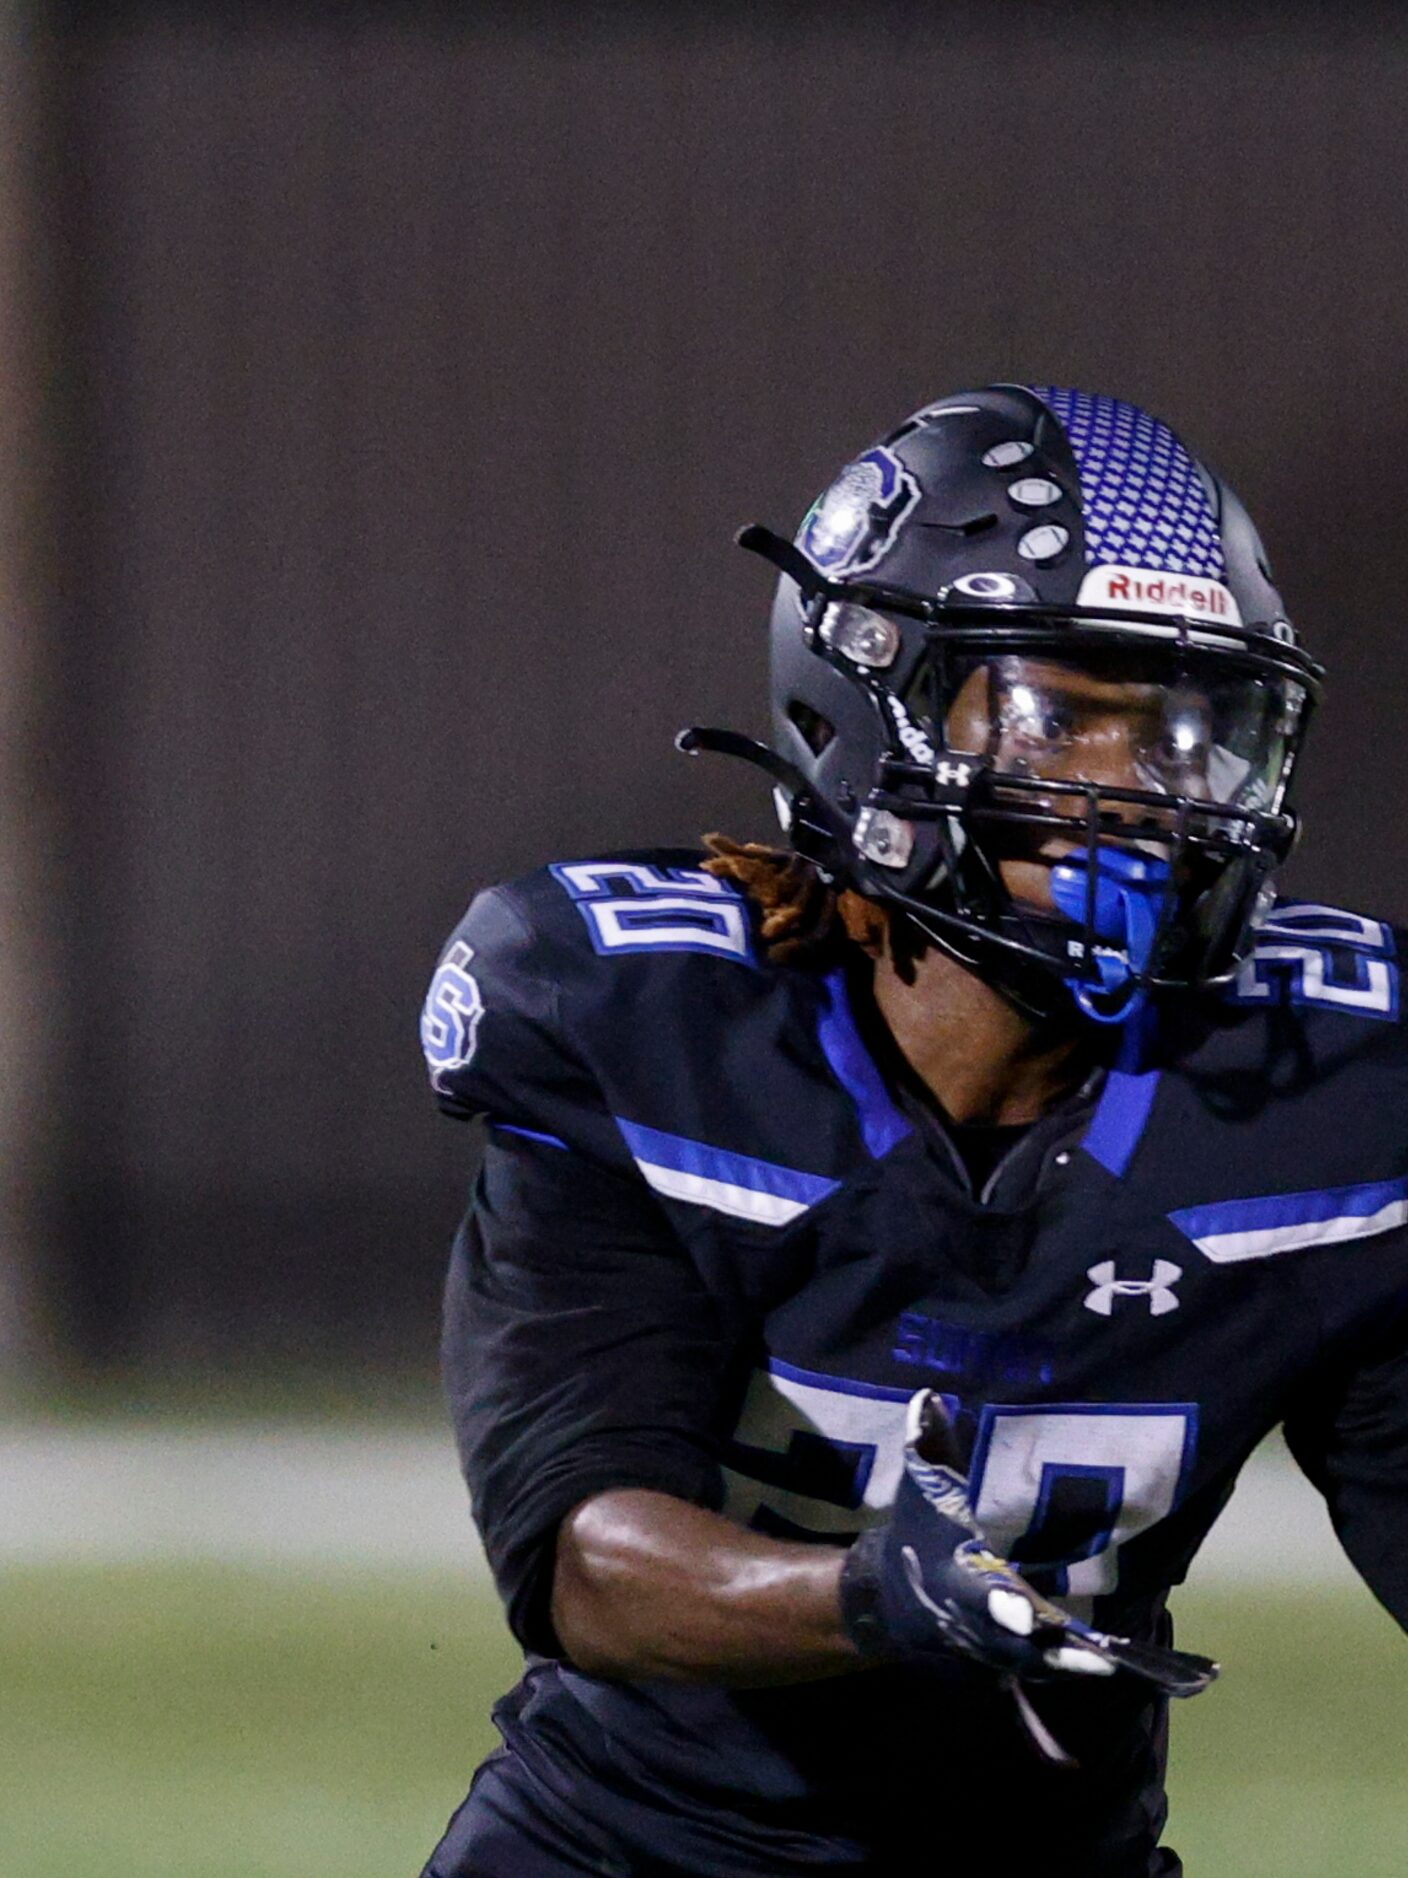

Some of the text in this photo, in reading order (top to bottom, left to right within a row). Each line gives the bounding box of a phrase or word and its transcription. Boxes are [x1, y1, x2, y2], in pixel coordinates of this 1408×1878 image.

[1107, 572, 1228, 616] Riddell
[549, 859, 759, 968] 20
[1222, 899, 1398, 1022] 20
